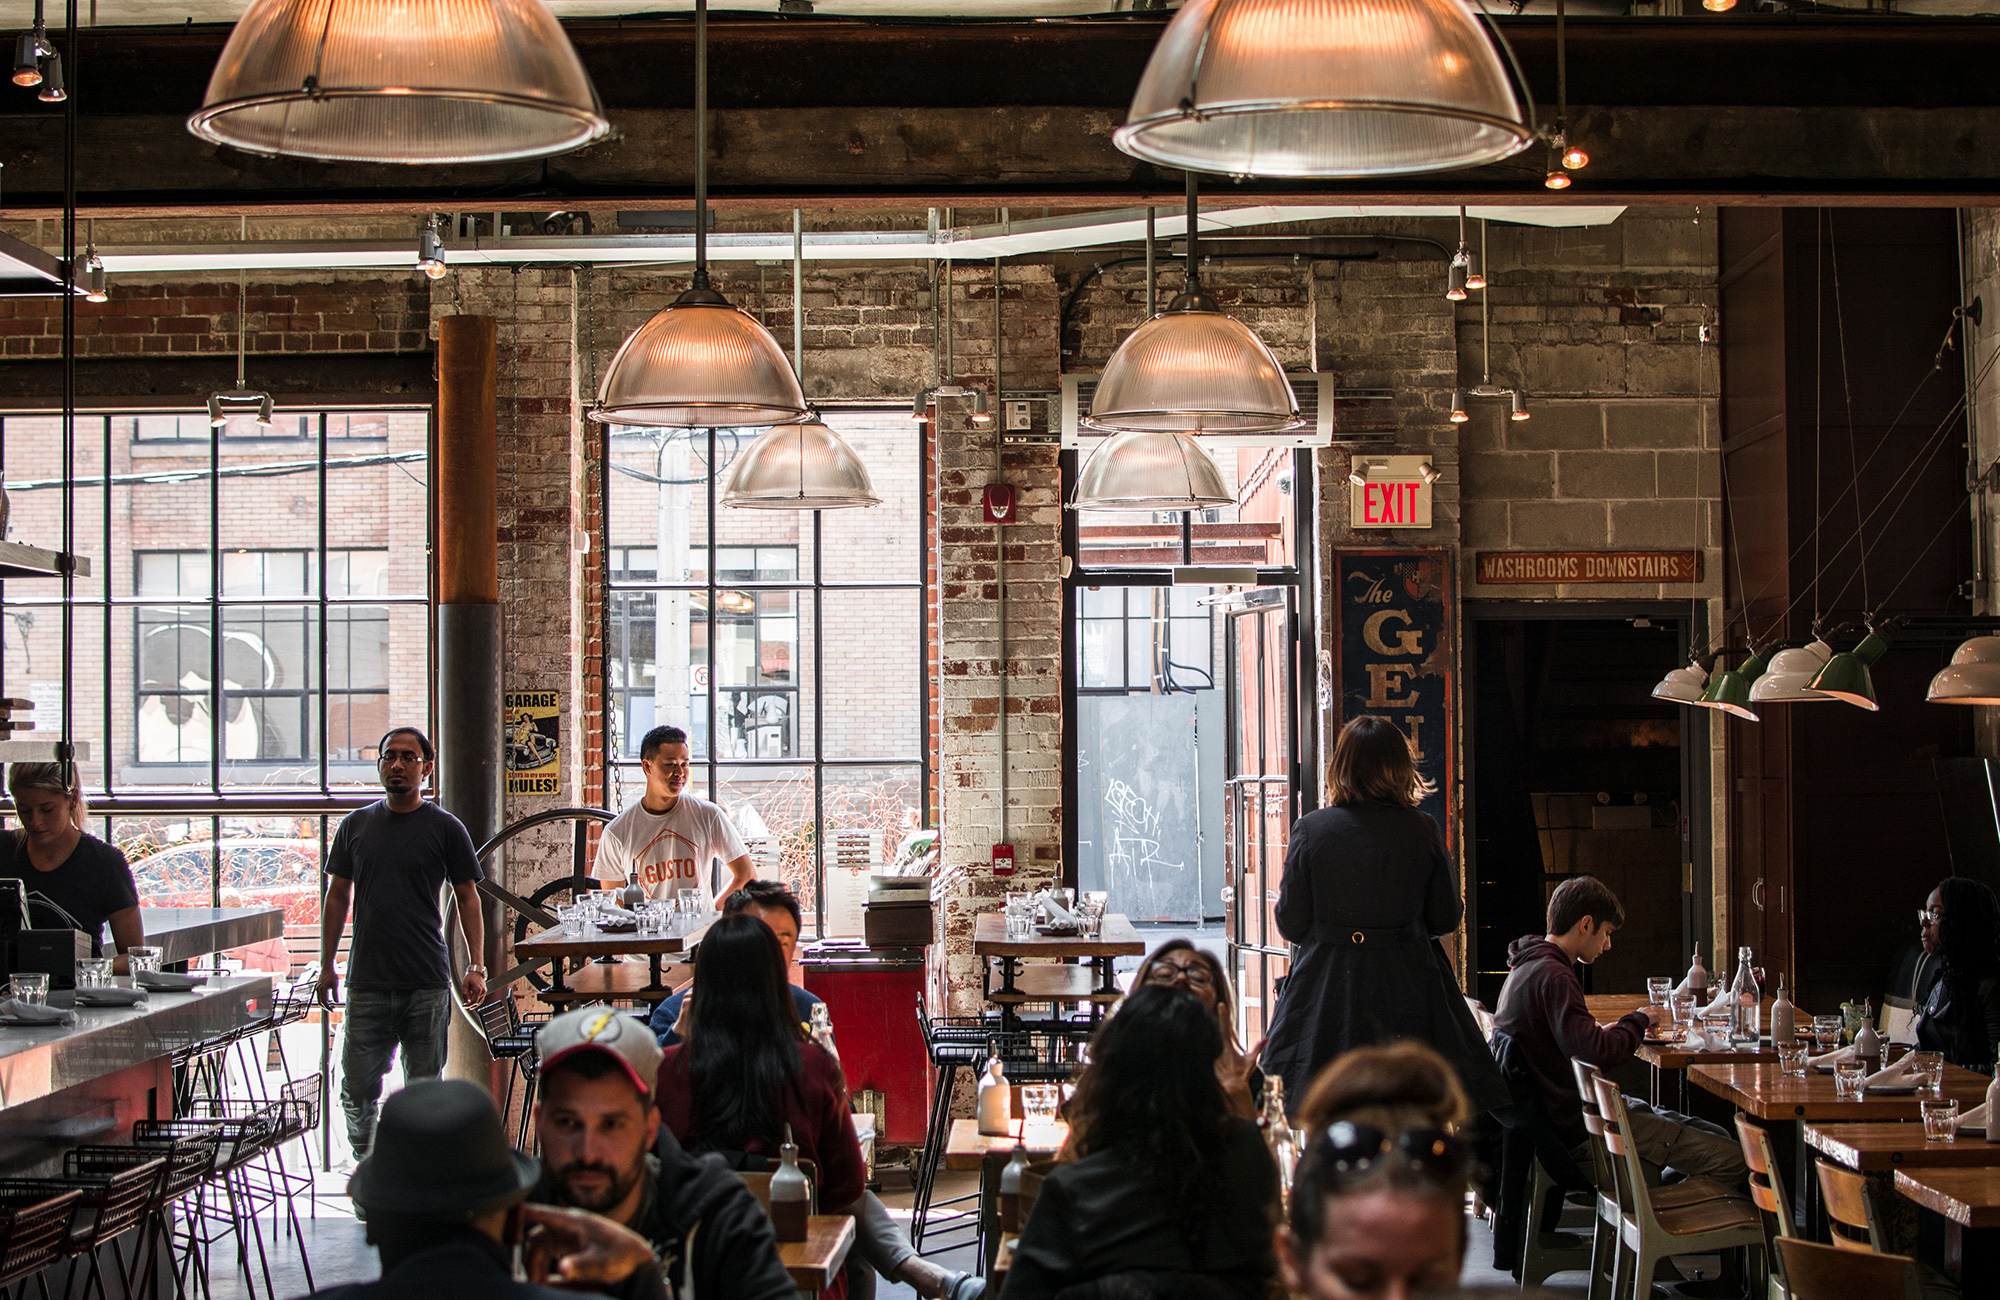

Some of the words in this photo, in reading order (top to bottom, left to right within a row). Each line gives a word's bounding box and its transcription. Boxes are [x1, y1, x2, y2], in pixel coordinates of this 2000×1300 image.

[1364, 483, 1420, 523] EXIT
[1484, 557, 1578, 578] WASHROOMS
[1585, 556, 1679, 577] DOWNSTAIRS
[1347, 571, 1393, 603] The
[505, 693, 556, 708] GARAGE
[509, 779, 557, 792] RULES!
[645, 858, 695, 884] GUSTO
